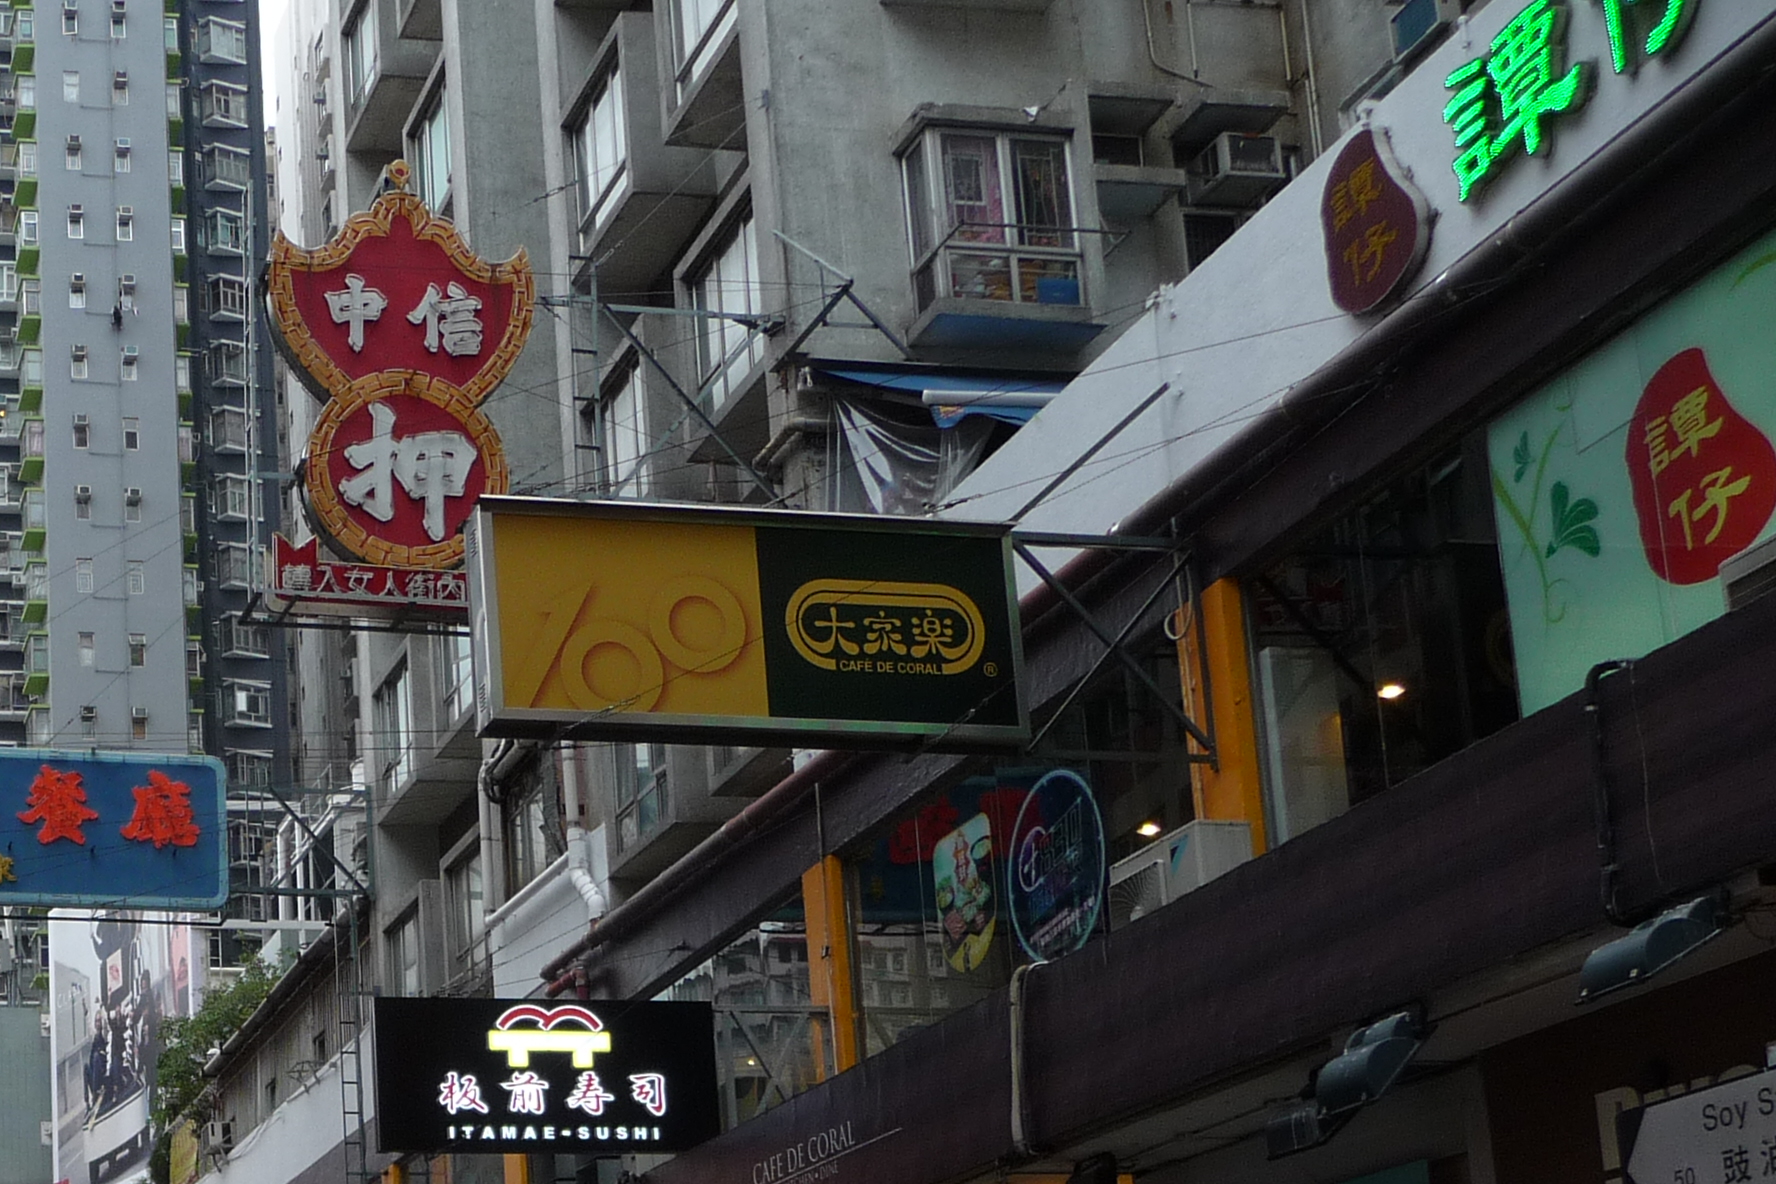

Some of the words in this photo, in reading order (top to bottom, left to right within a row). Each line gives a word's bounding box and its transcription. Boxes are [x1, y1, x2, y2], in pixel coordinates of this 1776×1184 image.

[338, 400, 477, 543] 押
[1645, 384, 1751, 551] 譚仔
[839, 657, 874, 672] CAFÉ
[877, 661, 895, 674] DE
[897, 662, 942, 676] CORAL
[446, 1124, 662, 1142] ITAMAE-SUSHI
[1701, 1099, 1748, 1133] Soy
[1758, 1087, 1776, 1117] S
[786, 1142, 806, 1174] DE
[806, 1120, 856, 1163] CORAL
